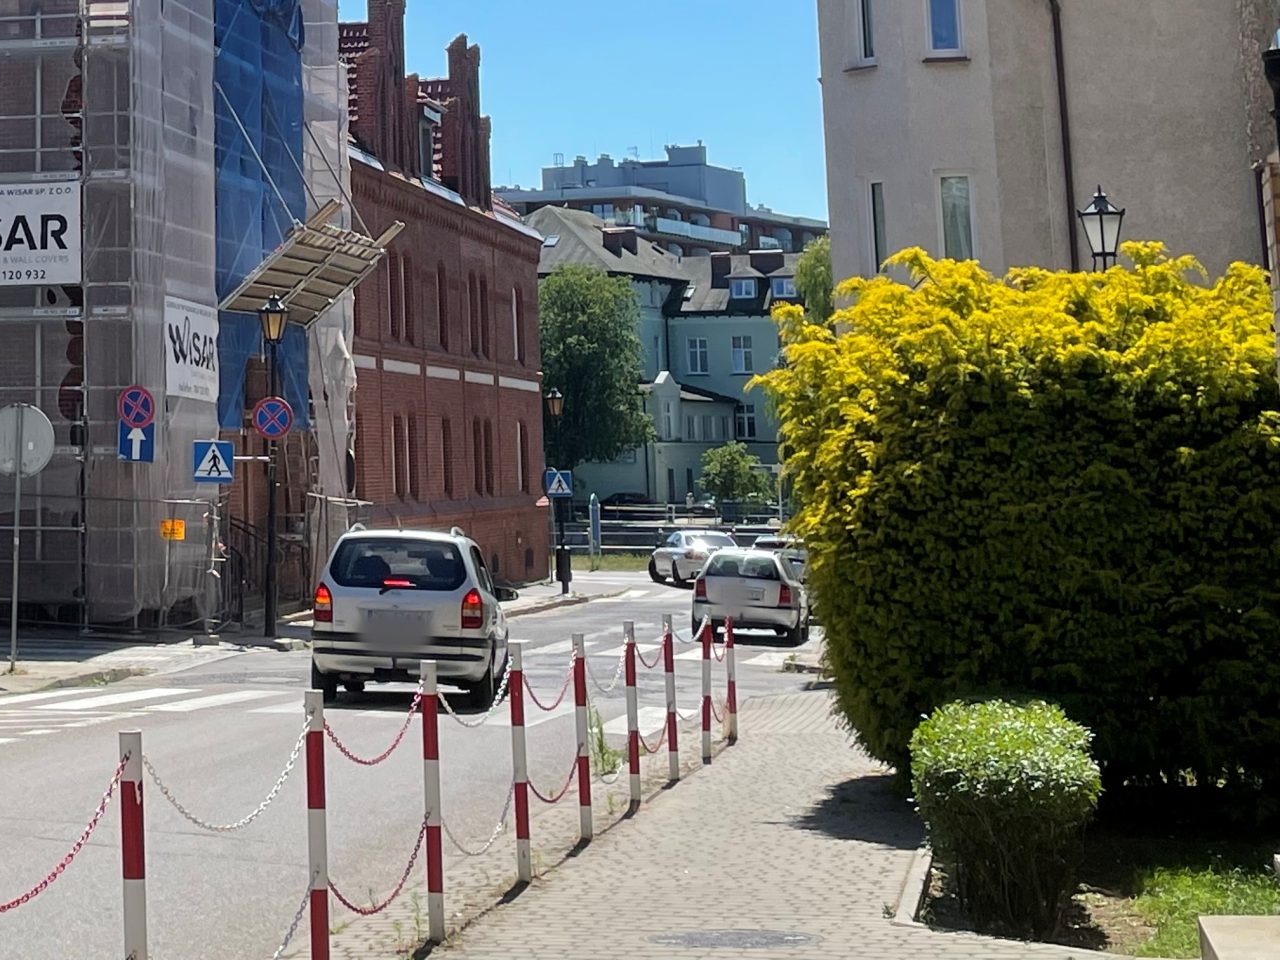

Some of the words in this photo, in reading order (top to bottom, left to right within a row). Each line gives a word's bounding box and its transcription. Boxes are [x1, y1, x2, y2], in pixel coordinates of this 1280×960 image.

[6, 188, 34, 196] WISAR
[10, 255, 34, 264] WALL
[35, 254, 69, 264] COVERS
[2, 270, 22, 281] 120
[25, 269, 46, 280] 932
